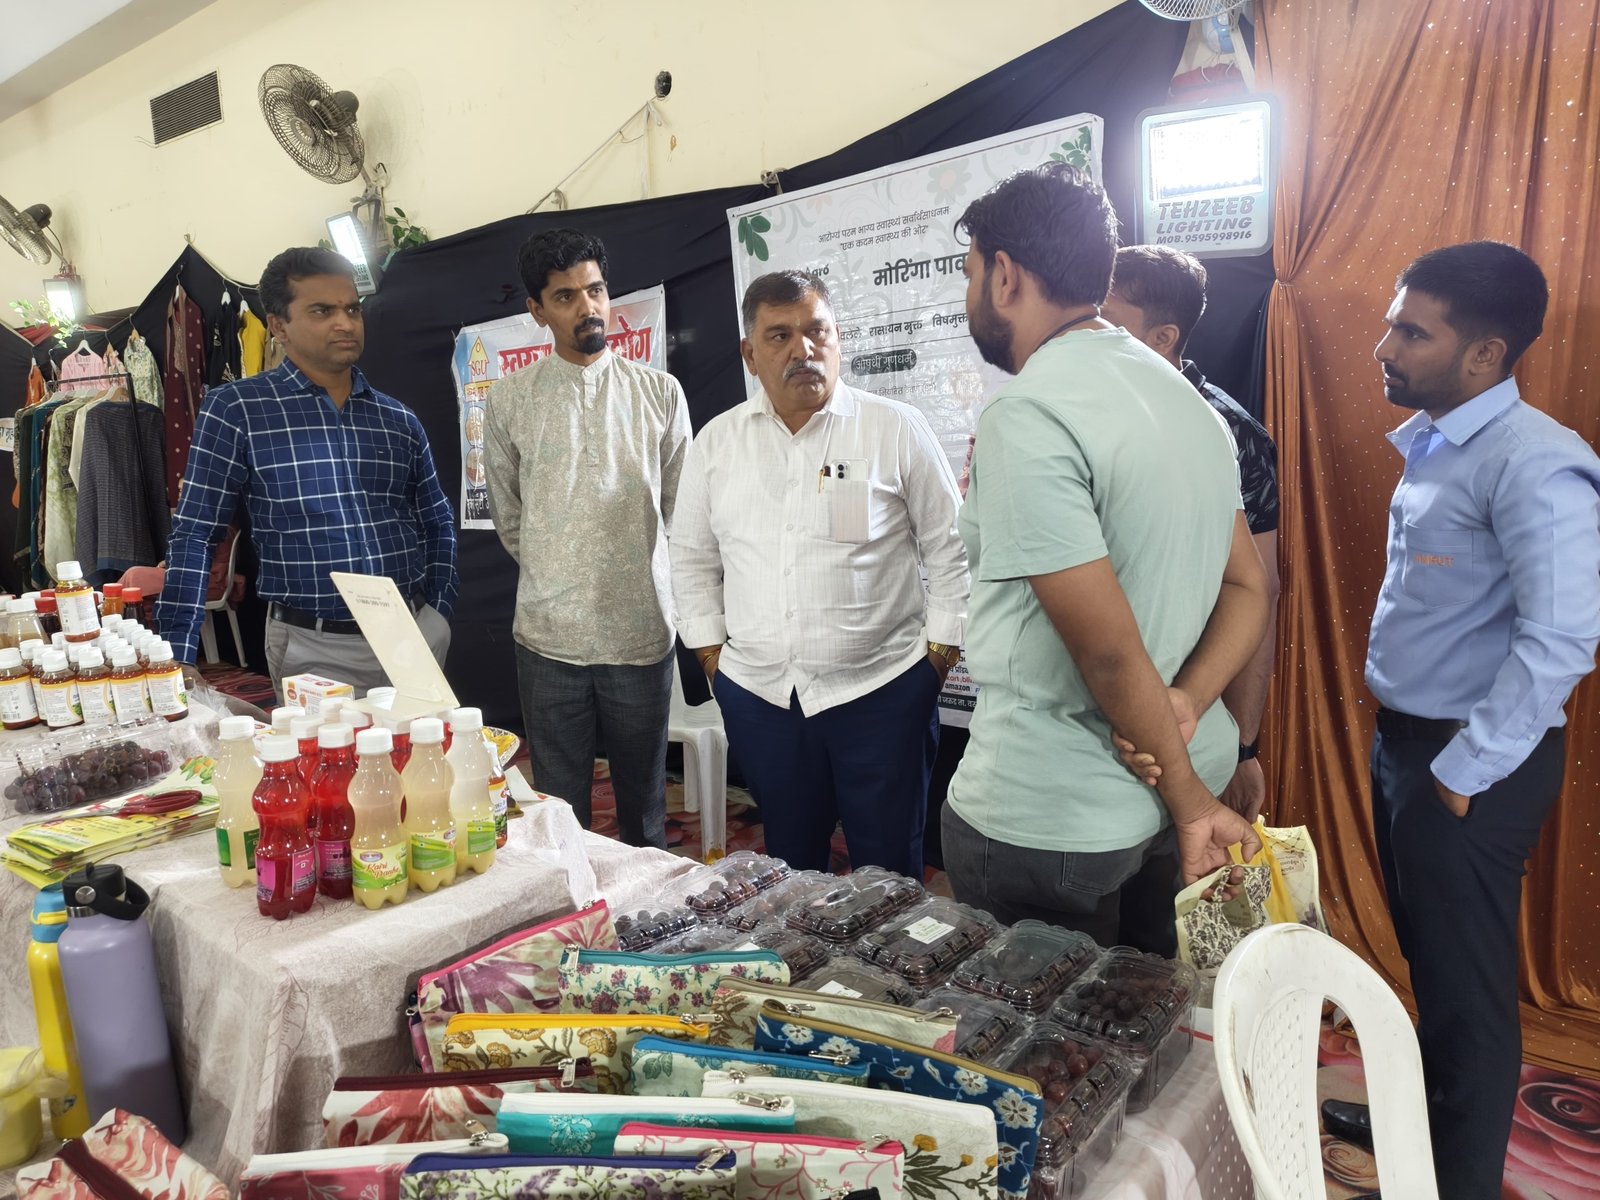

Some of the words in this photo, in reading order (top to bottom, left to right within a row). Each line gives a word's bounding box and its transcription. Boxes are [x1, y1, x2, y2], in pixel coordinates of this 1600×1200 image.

[1158, 196, 1255, 221] TEHZEEB
[841, 227, 857, 238] परम
[1156, 217, 1252, 235] LIGHTING
[856, 237, 874, 248] कदम
[875, 231, 899, 244] स्वास्थ्य
[901, 225, 911, 238] की
[1156, 230, 1252, 245] MOB.9595998916
[872, 258, 931, 287] मोरिंगा
[934, 252, 968, 276] पाव
[904, 320, 923, 335] मुक्त
[470, 359, 487, 377] SGU
[945, 683, 970, 691] amazon
